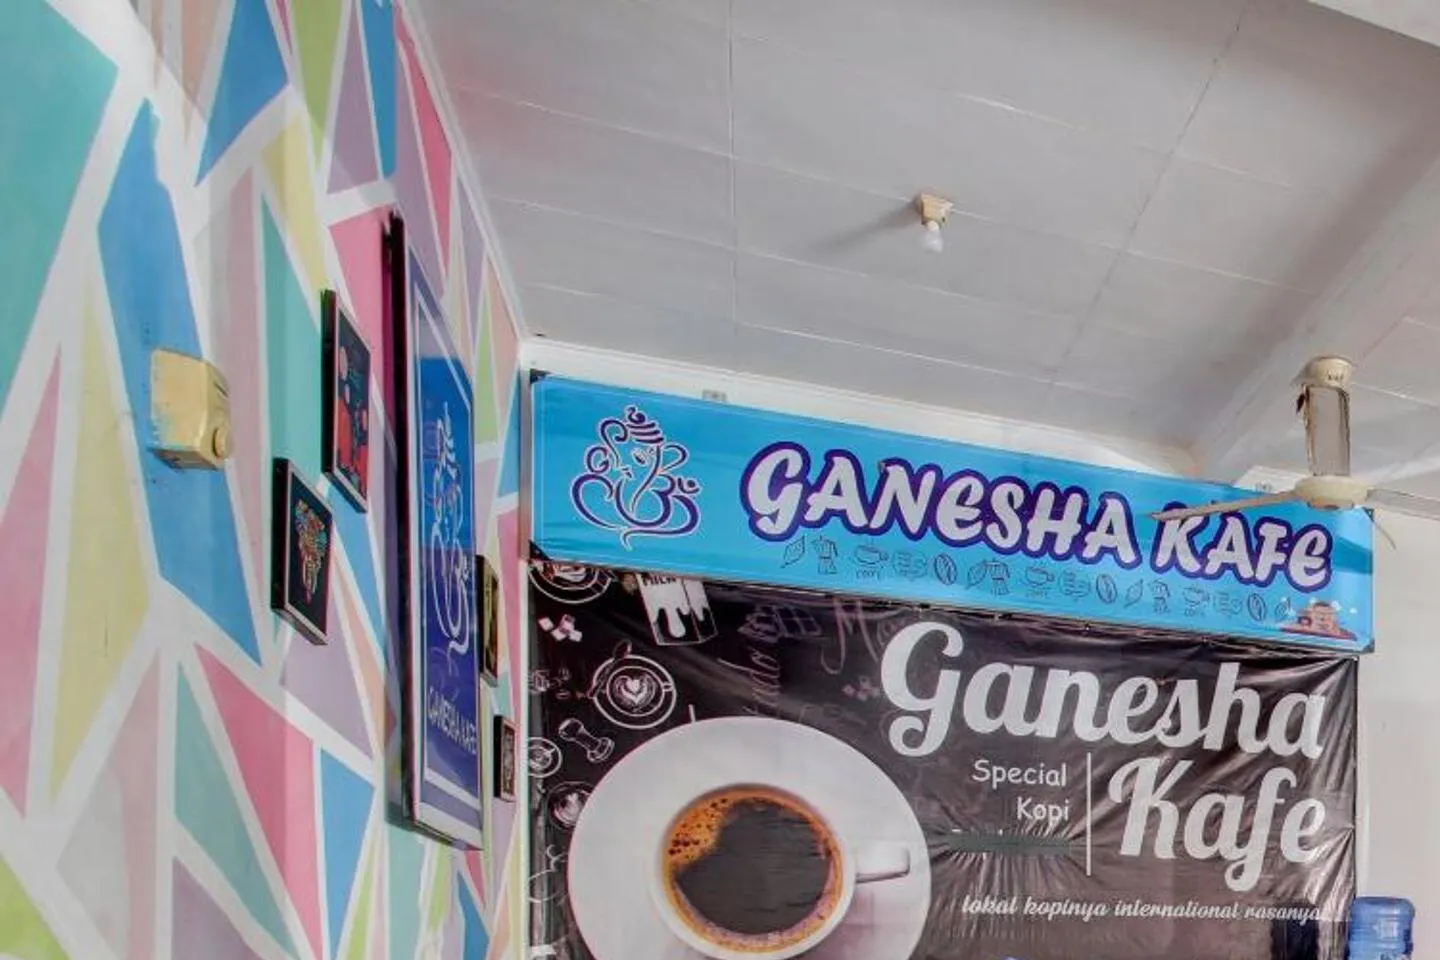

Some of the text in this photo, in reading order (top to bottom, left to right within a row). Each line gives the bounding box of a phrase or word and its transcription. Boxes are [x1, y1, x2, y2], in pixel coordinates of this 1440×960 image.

[740, 441, 1334, 592] GANESHA KAFE
[881, 621, 1327, 760] Ganesha
[972, 760, 1067, 790] Special
[1016, 797, 1071, 826] Kopi
[1108, 756, 1327, 892] Kafe
[962, 895, 1321, 926] lokal kopinya international rasanya
